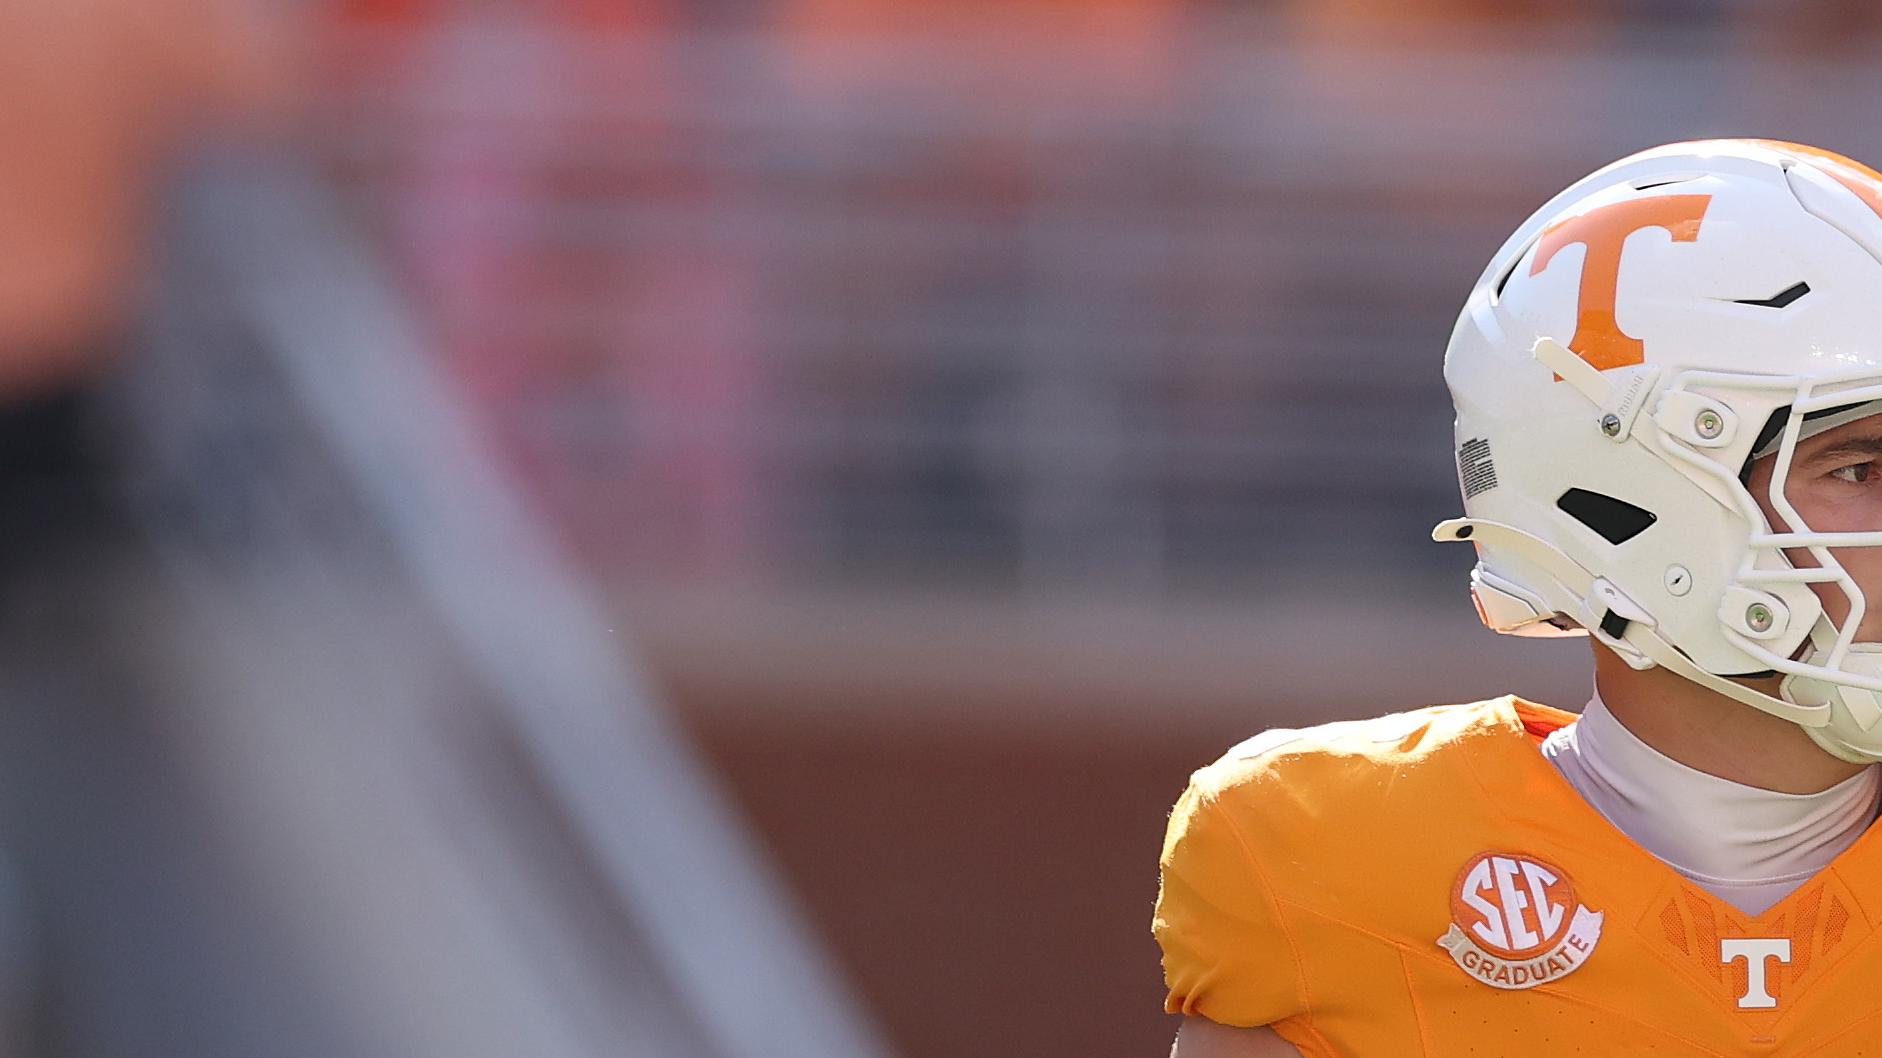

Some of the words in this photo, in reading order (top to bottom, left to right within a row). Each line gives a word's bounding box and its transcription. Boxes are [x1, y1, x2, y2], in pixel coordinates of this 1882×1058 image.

[1529, 194, 1713, 383] T
[1461, 856, 1566, 950] SEC
[1462, 933, 1589, 985] GRADUATE
[1721, 938, 1791, 1008] T
